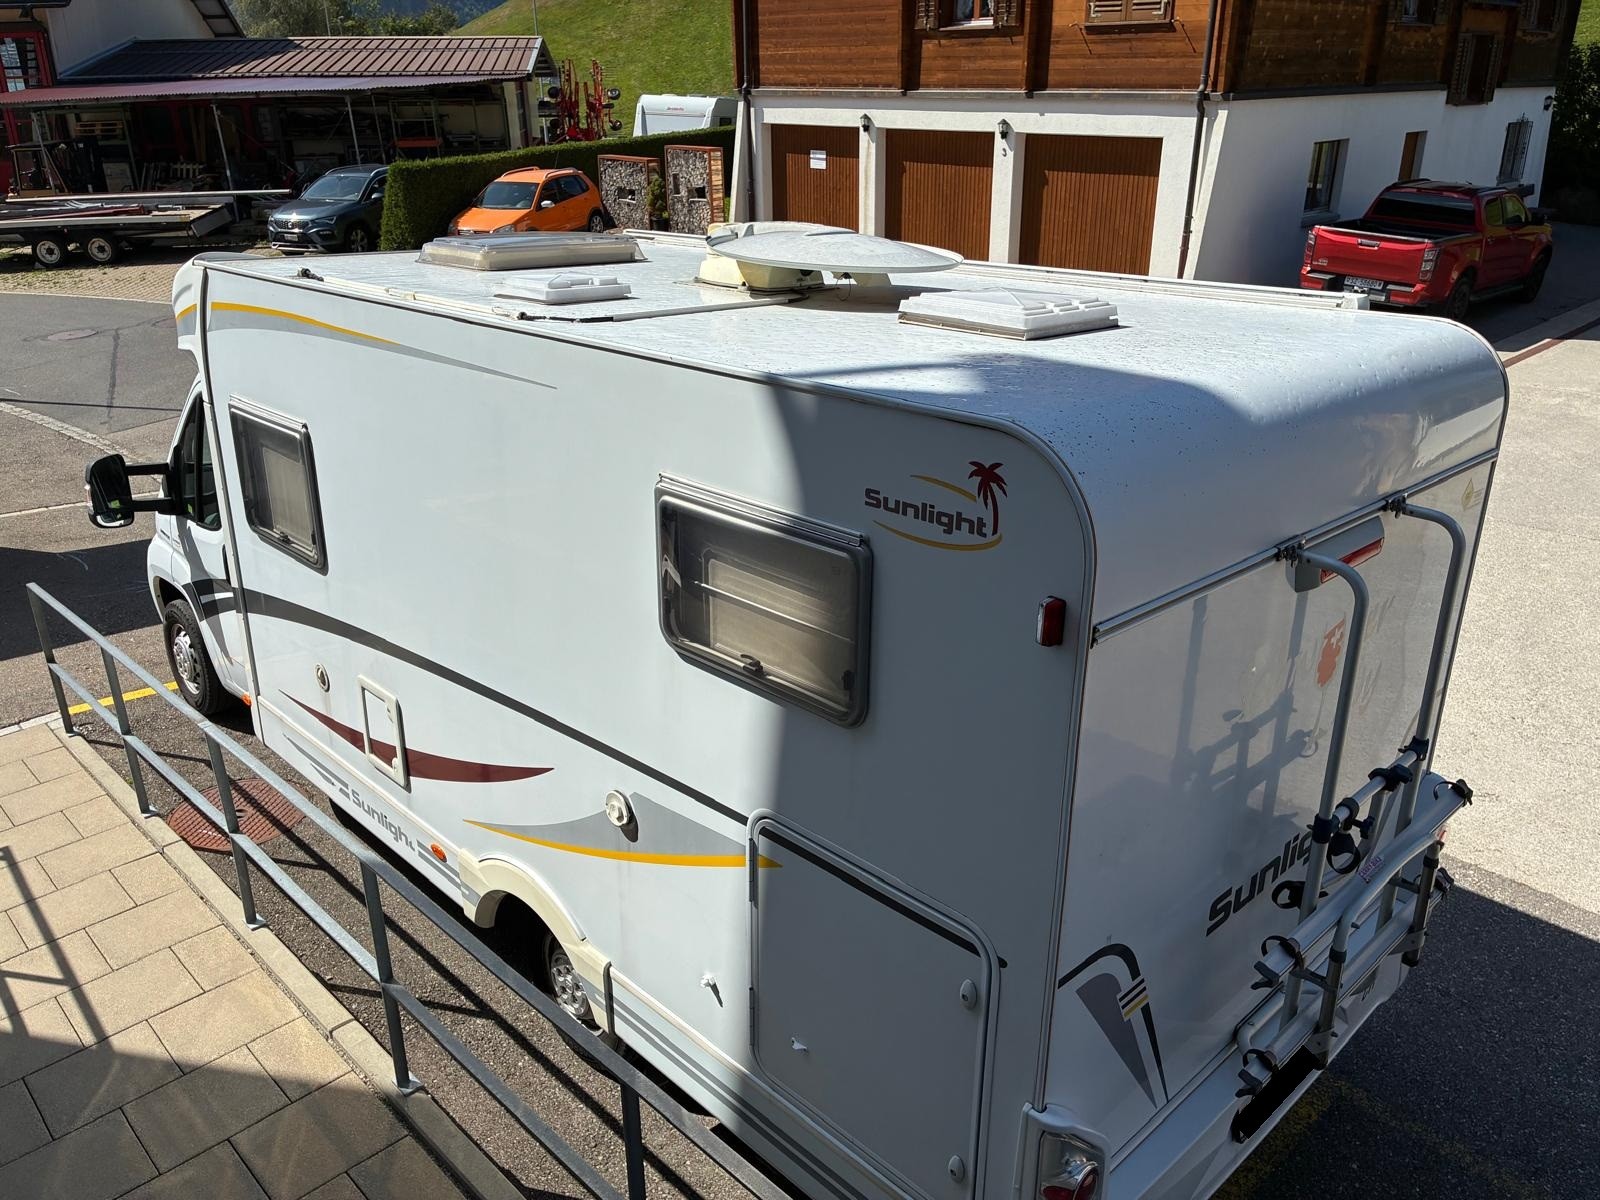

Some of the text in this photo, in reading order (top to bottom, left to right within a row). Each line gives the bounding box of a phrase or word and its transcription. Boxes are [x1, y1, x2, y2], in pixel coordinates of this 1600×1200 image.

[864, 487, 987, 538] Sunlight
[351, 788, 416, 852] Sunlight
[1205, 830, 1313, 937] Sunlig
